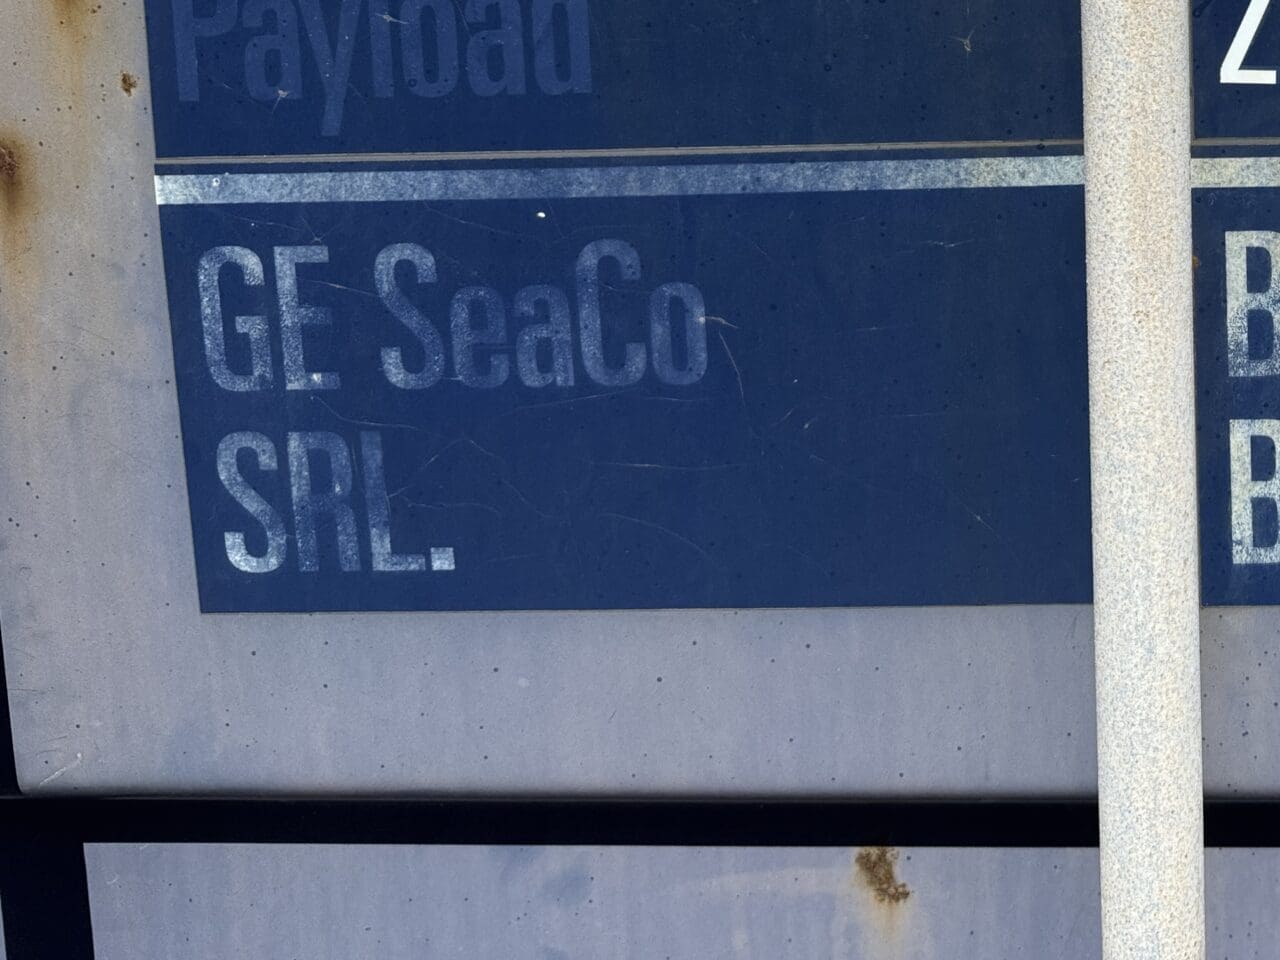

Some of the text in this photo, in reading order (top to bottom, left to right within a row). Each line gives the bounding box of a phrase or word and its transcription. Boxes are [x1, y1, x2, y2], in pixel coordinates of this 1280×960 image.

[199, 238, 709, 392] GE SeaCo
[215, 430, 455, 573] SRL.
